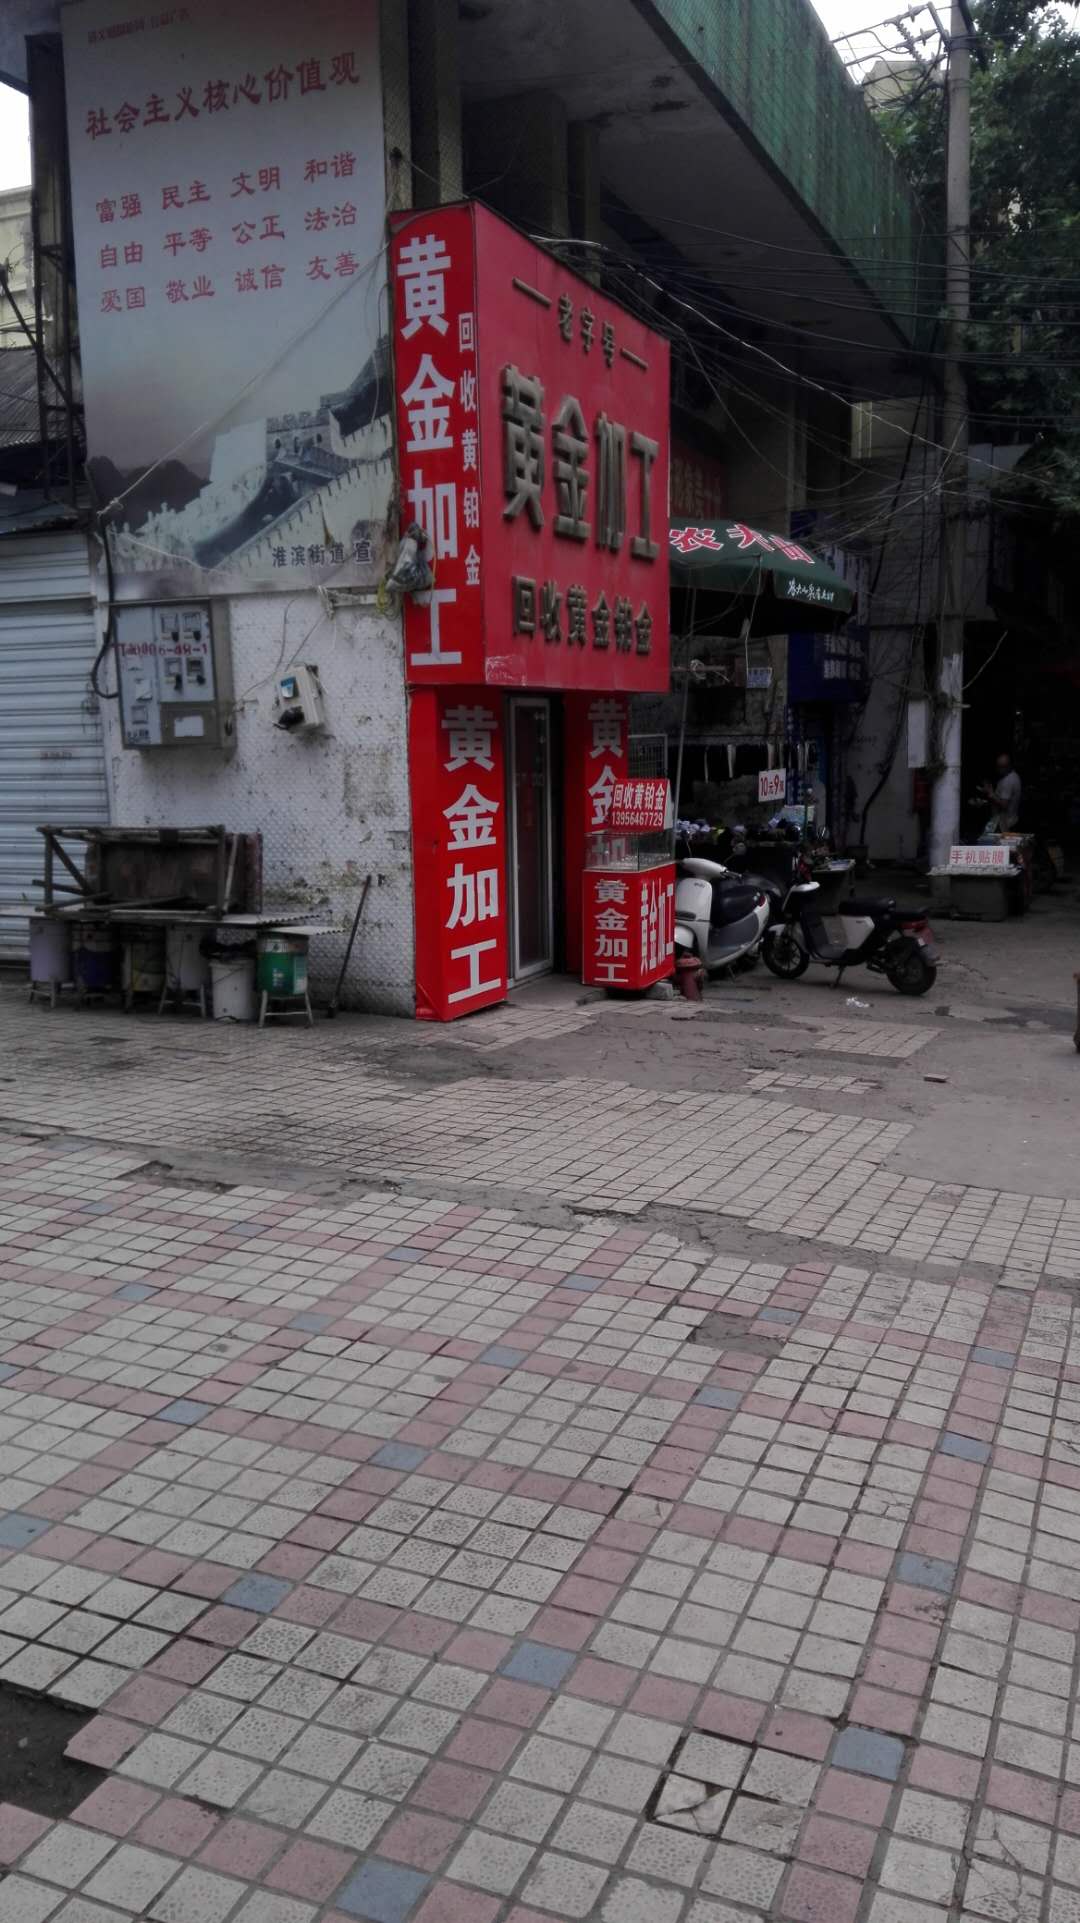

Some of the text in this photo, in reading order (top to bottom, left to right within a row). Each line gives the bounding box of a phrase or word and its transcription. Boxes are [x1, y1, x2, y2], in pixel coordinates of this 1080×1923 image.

[86, 51, 361, 140] 社会主义核心价值观
[96, 151, 356, 224] 富强 民主 文明 和谐
[99, 201, 357, 269] 自由 平等 公正 法治
[100, 250, 360, 313] 爱国 敬业 诚信 友善
[396, 234, 463, 666] 黄金加工
[458, 312, 481, 586] 回收黄铂金
[501, 363, 660, 562] 黄金加工
[612, 783, 665, 811] 回收黄铂金
[612, 811, 664, 827] 13956467729
[441, 705, 501, 1005] 黄金加工
[951, 849, 1004, 865] 手机贴膜
[594, 879, 630, 983] 黄金加工
[640, 878, 674, 977] 黄金加工
